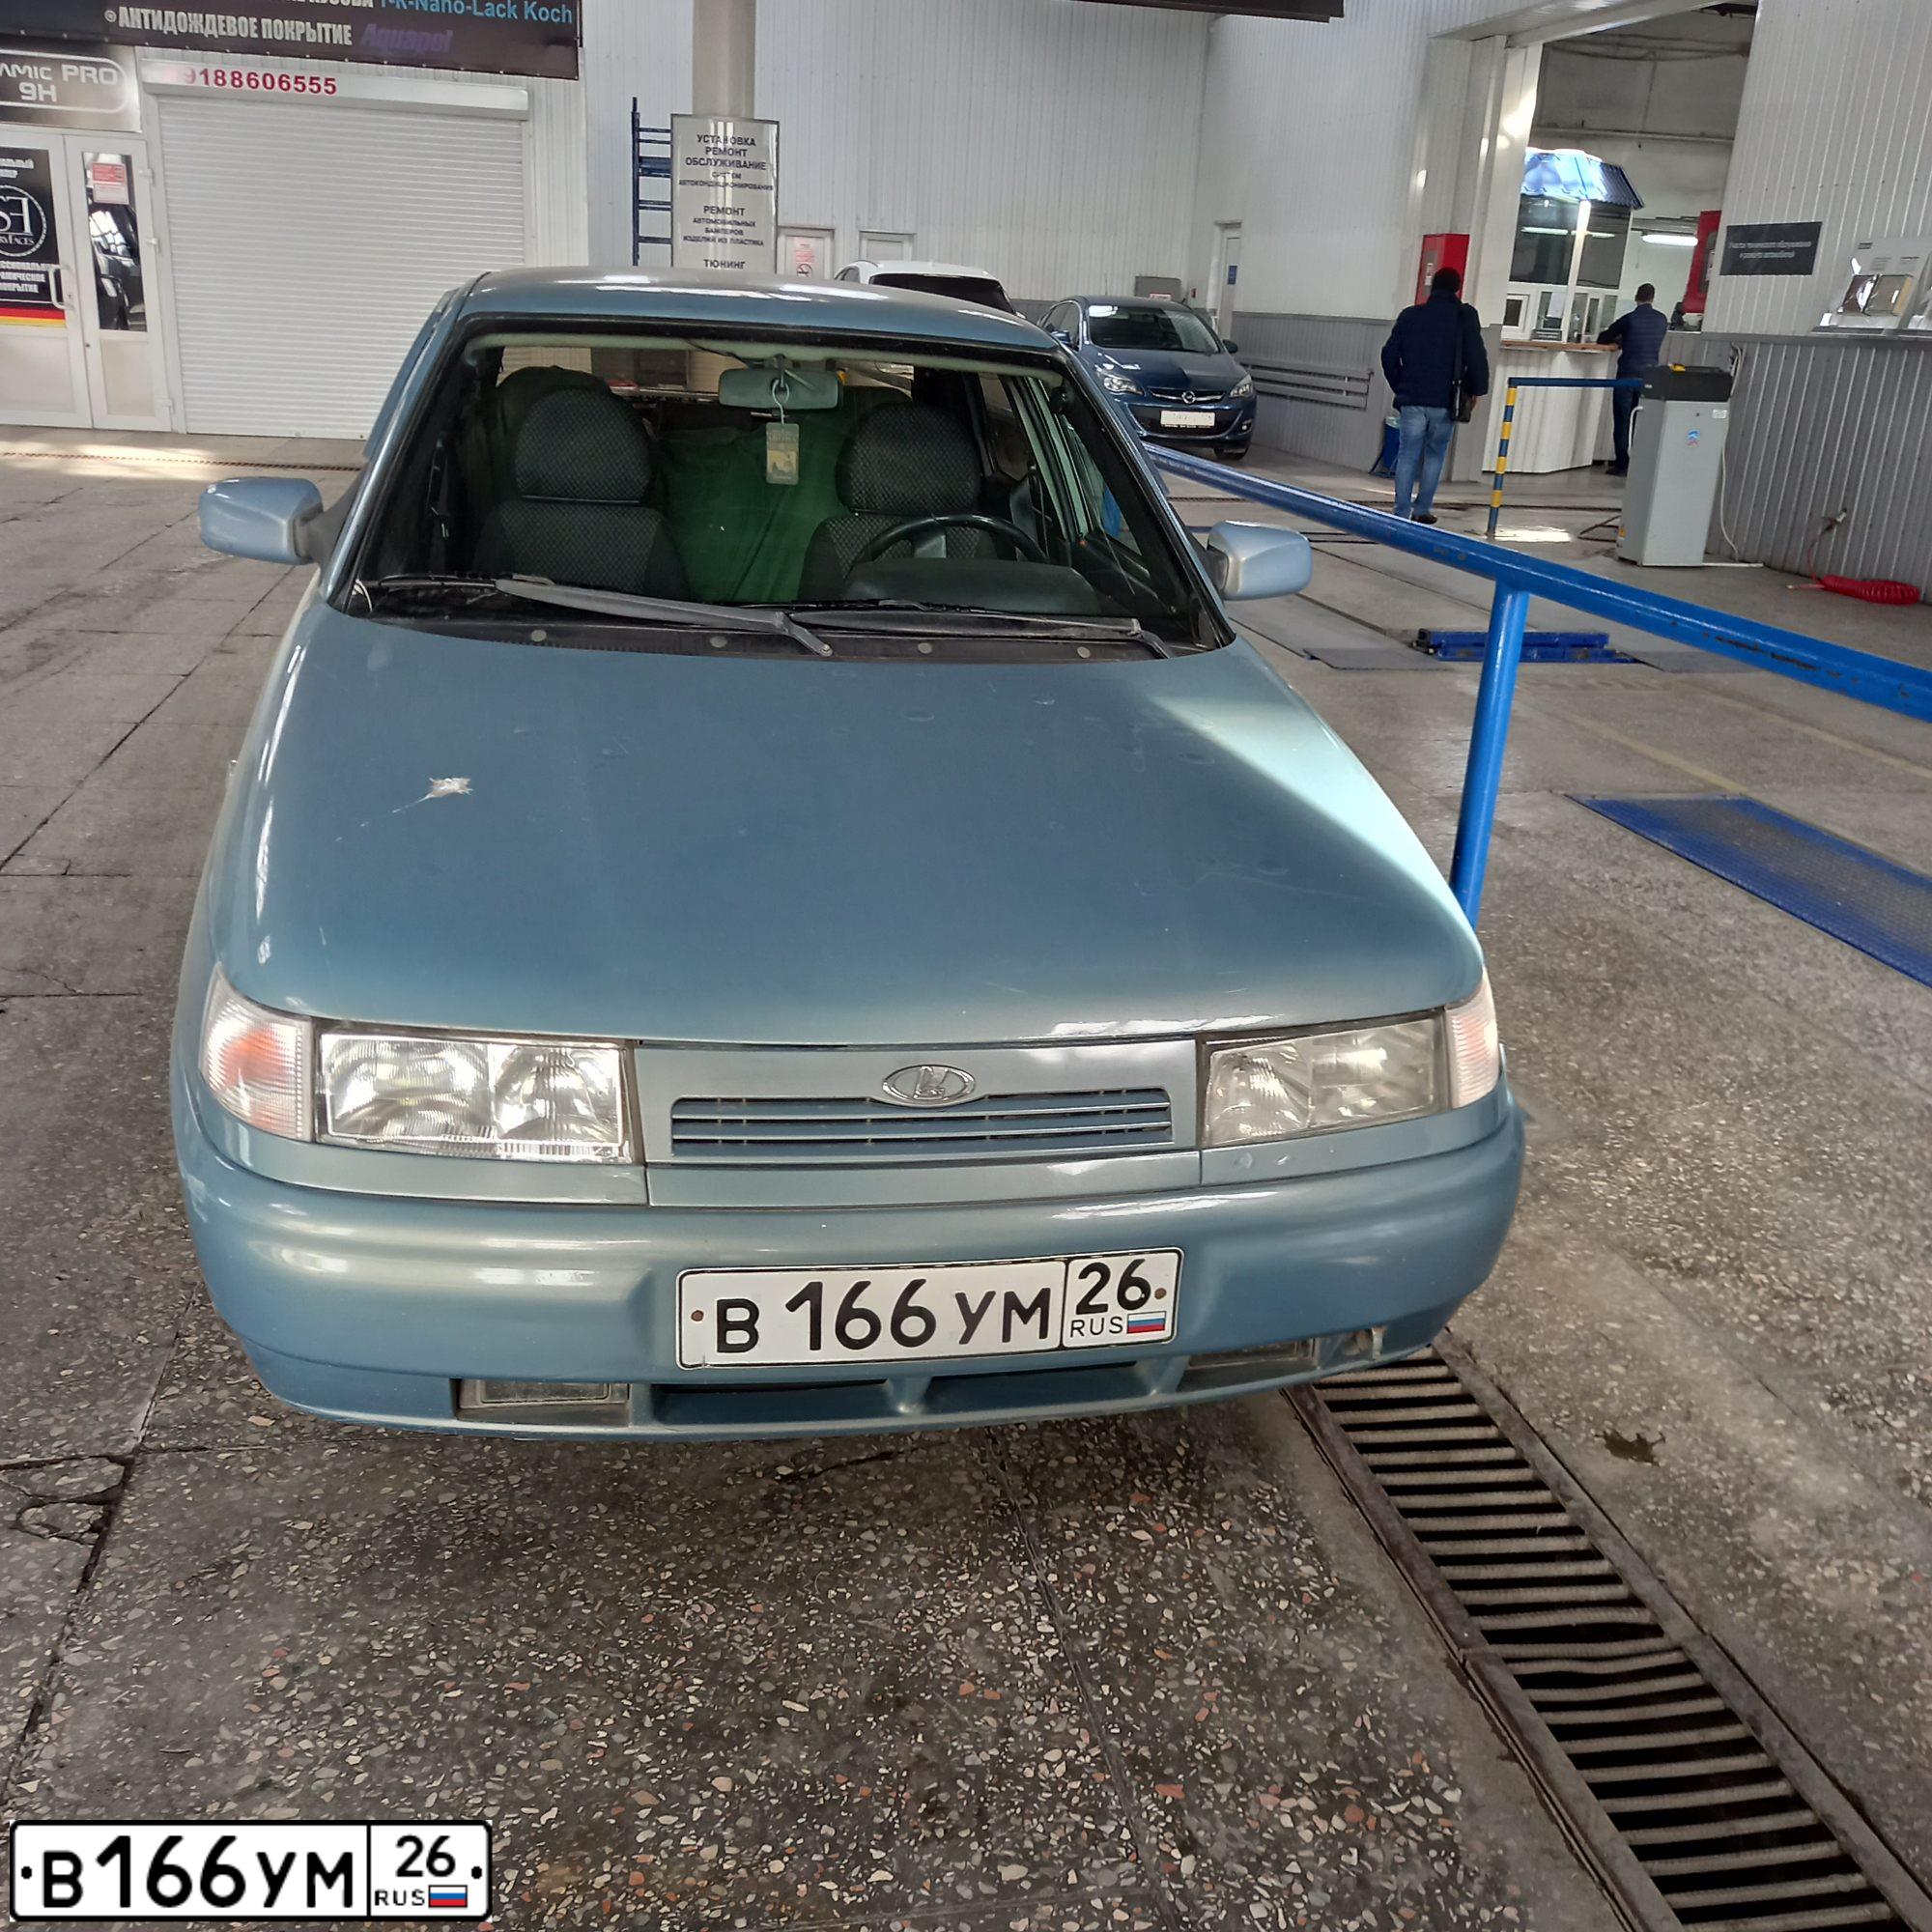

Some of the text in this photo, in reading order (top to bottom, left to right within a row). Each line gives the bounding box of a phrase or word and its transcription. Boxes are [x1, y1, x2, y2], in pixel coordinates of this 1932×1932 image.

[524, 1, 573, 23] Koch
[118, 6, 259, 39] АНТИДОЖДЕВОЕ
[261, 17, 353, 45] ПОКРЫТИЕ
[61, 64, 118, 85] PRO
[19, 81, 57, 102] 9H
[696, 134, 756, 146] УСТАНОВКА
[705, 146, 748, 156] РЕМОНТ
[685, 156, 767, 170] ОБСЛУЖИВАНИЕ
[703, 205, 746, 215] РЕМОНТ
[703, 259, 746, 270] ТЮНИНГ
[1075, 1258, 1151, 1315] 26
[1069, 1315, 1123, 1338] RUS
